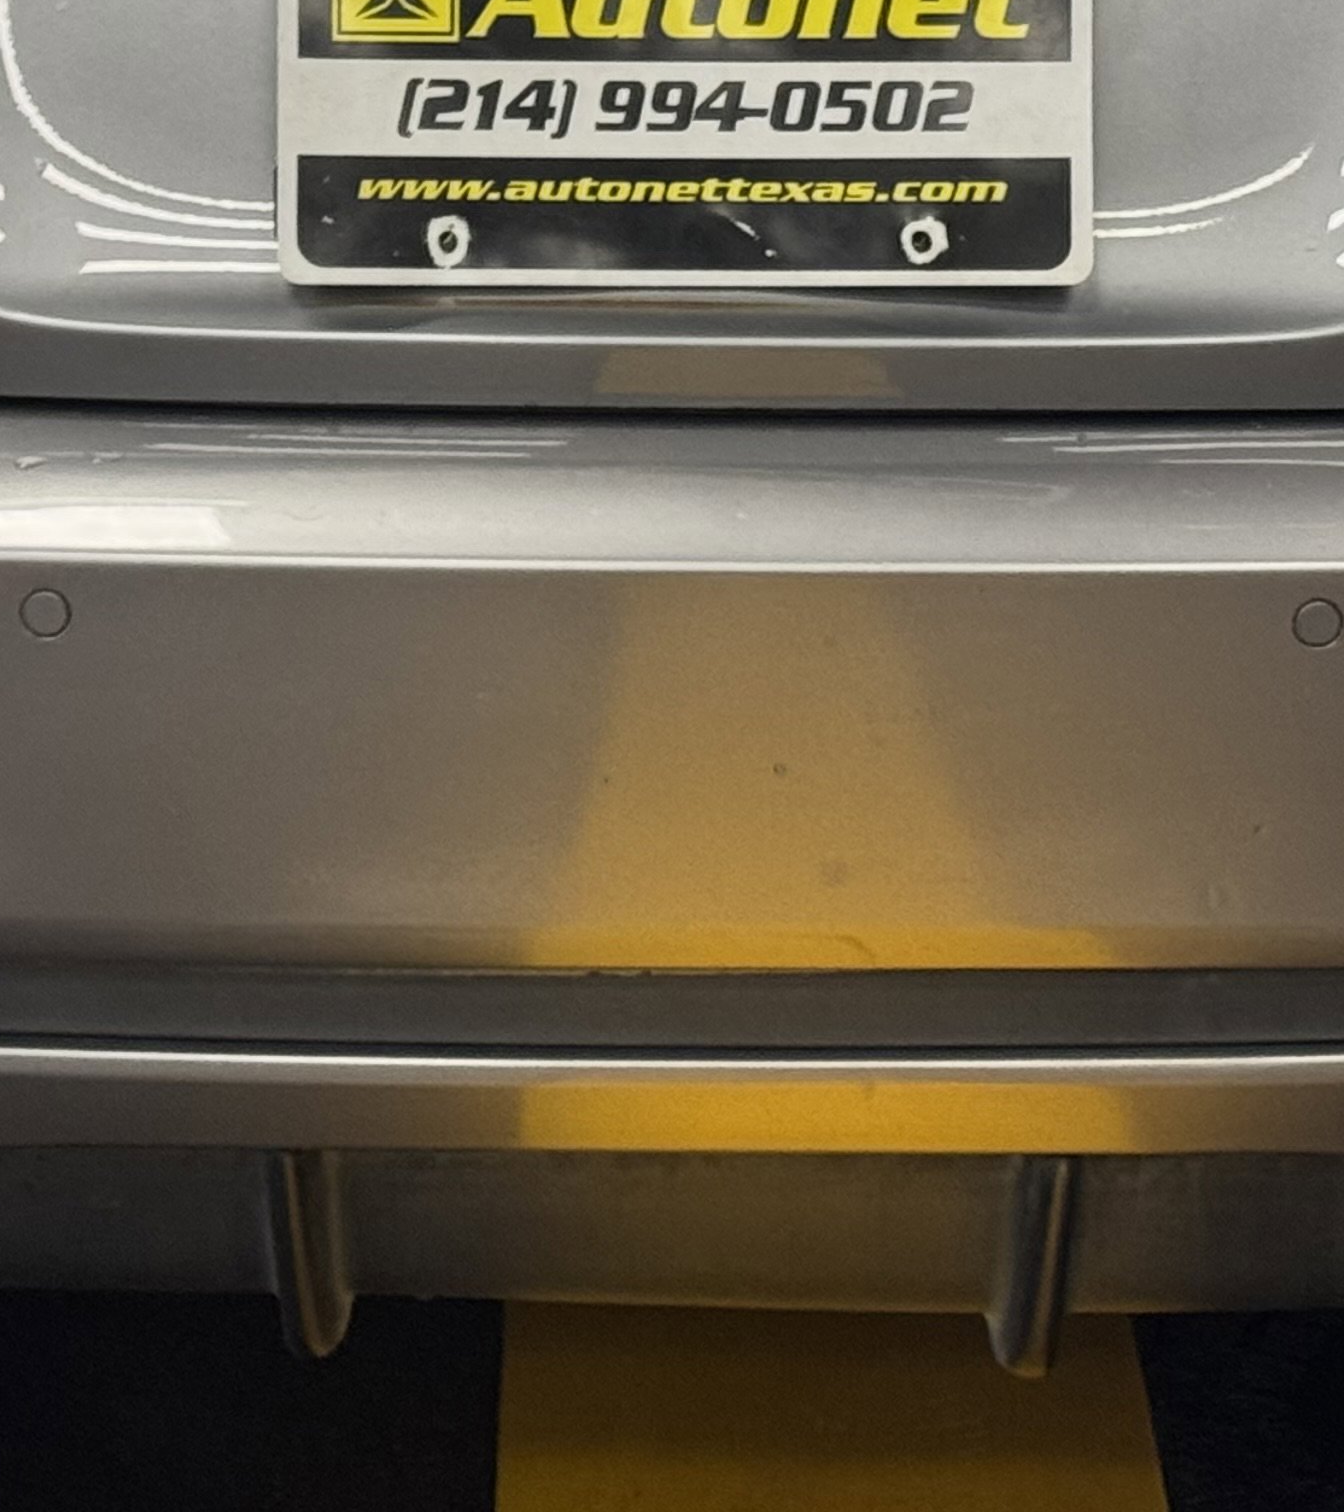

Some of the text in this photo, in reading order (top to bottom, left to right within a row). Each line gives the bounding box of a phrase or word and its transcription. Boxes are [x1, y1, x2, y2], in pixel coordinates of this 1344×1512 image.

[397, 78, 975, 139] (214) 994-0502
[357, 176, 1007, 204] www.autonettexas.com
